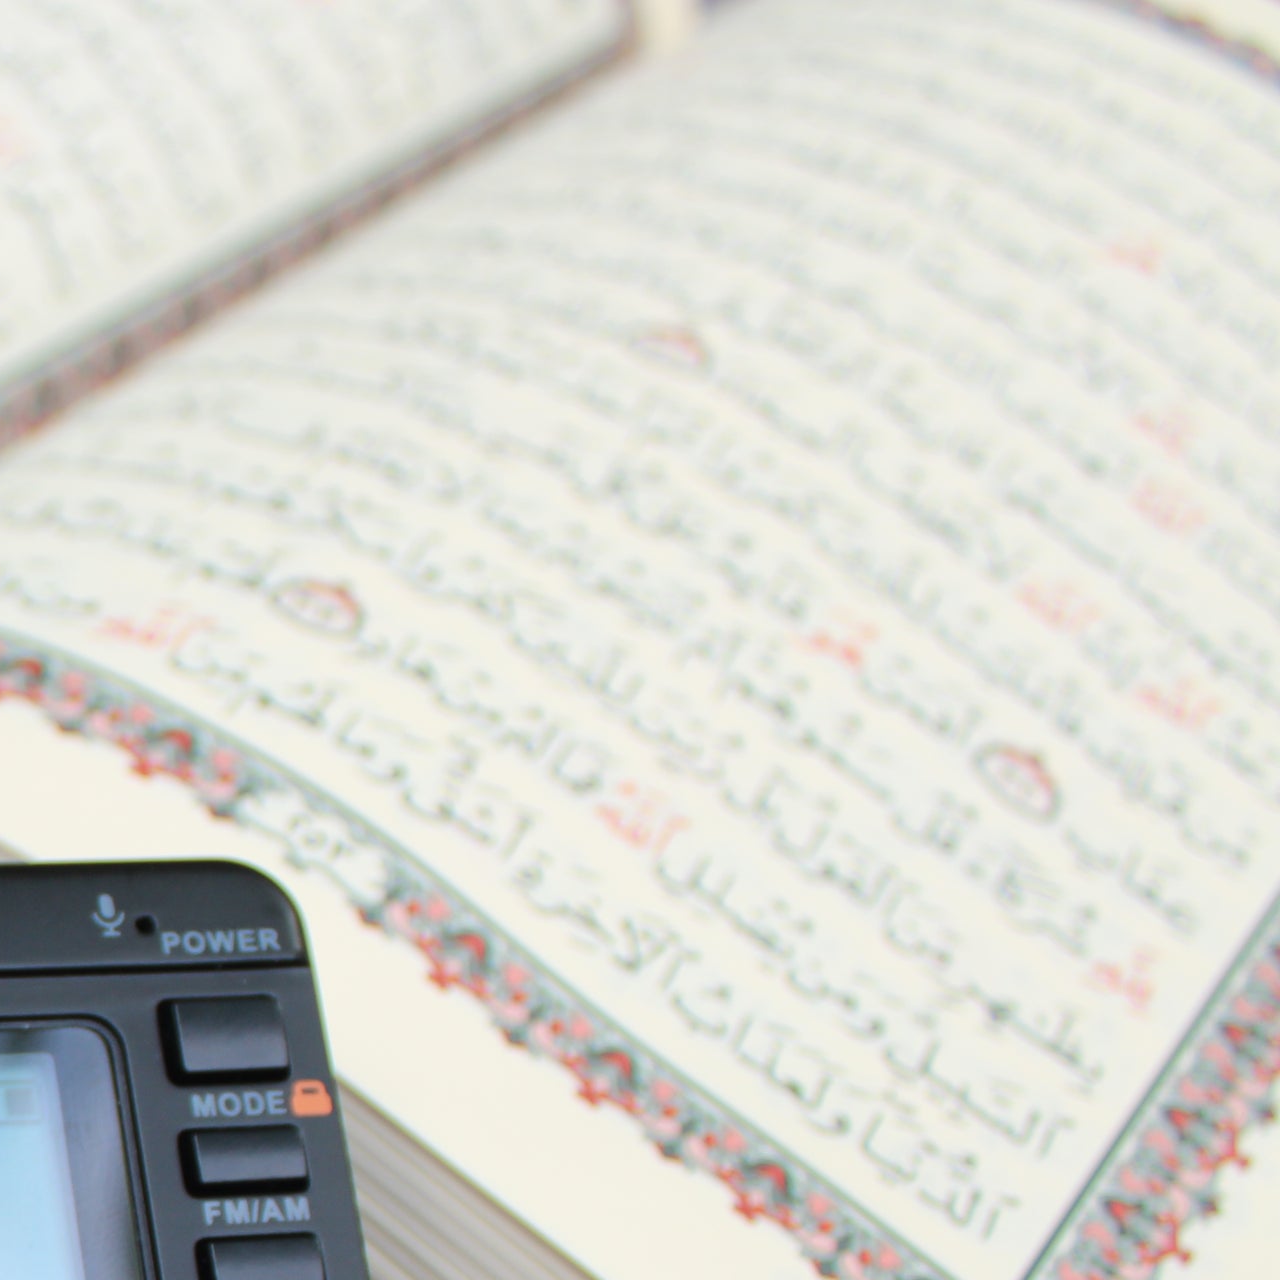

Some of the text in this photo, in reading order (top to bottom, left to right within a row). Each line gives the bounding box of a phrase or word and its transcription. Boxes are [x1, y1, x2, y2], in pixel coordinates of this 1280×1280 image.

[162, 928, 281, 955] POWER
[191, 1090, 288, 1118] MODE
[203, 1198, 311, 1225] FM/AM
